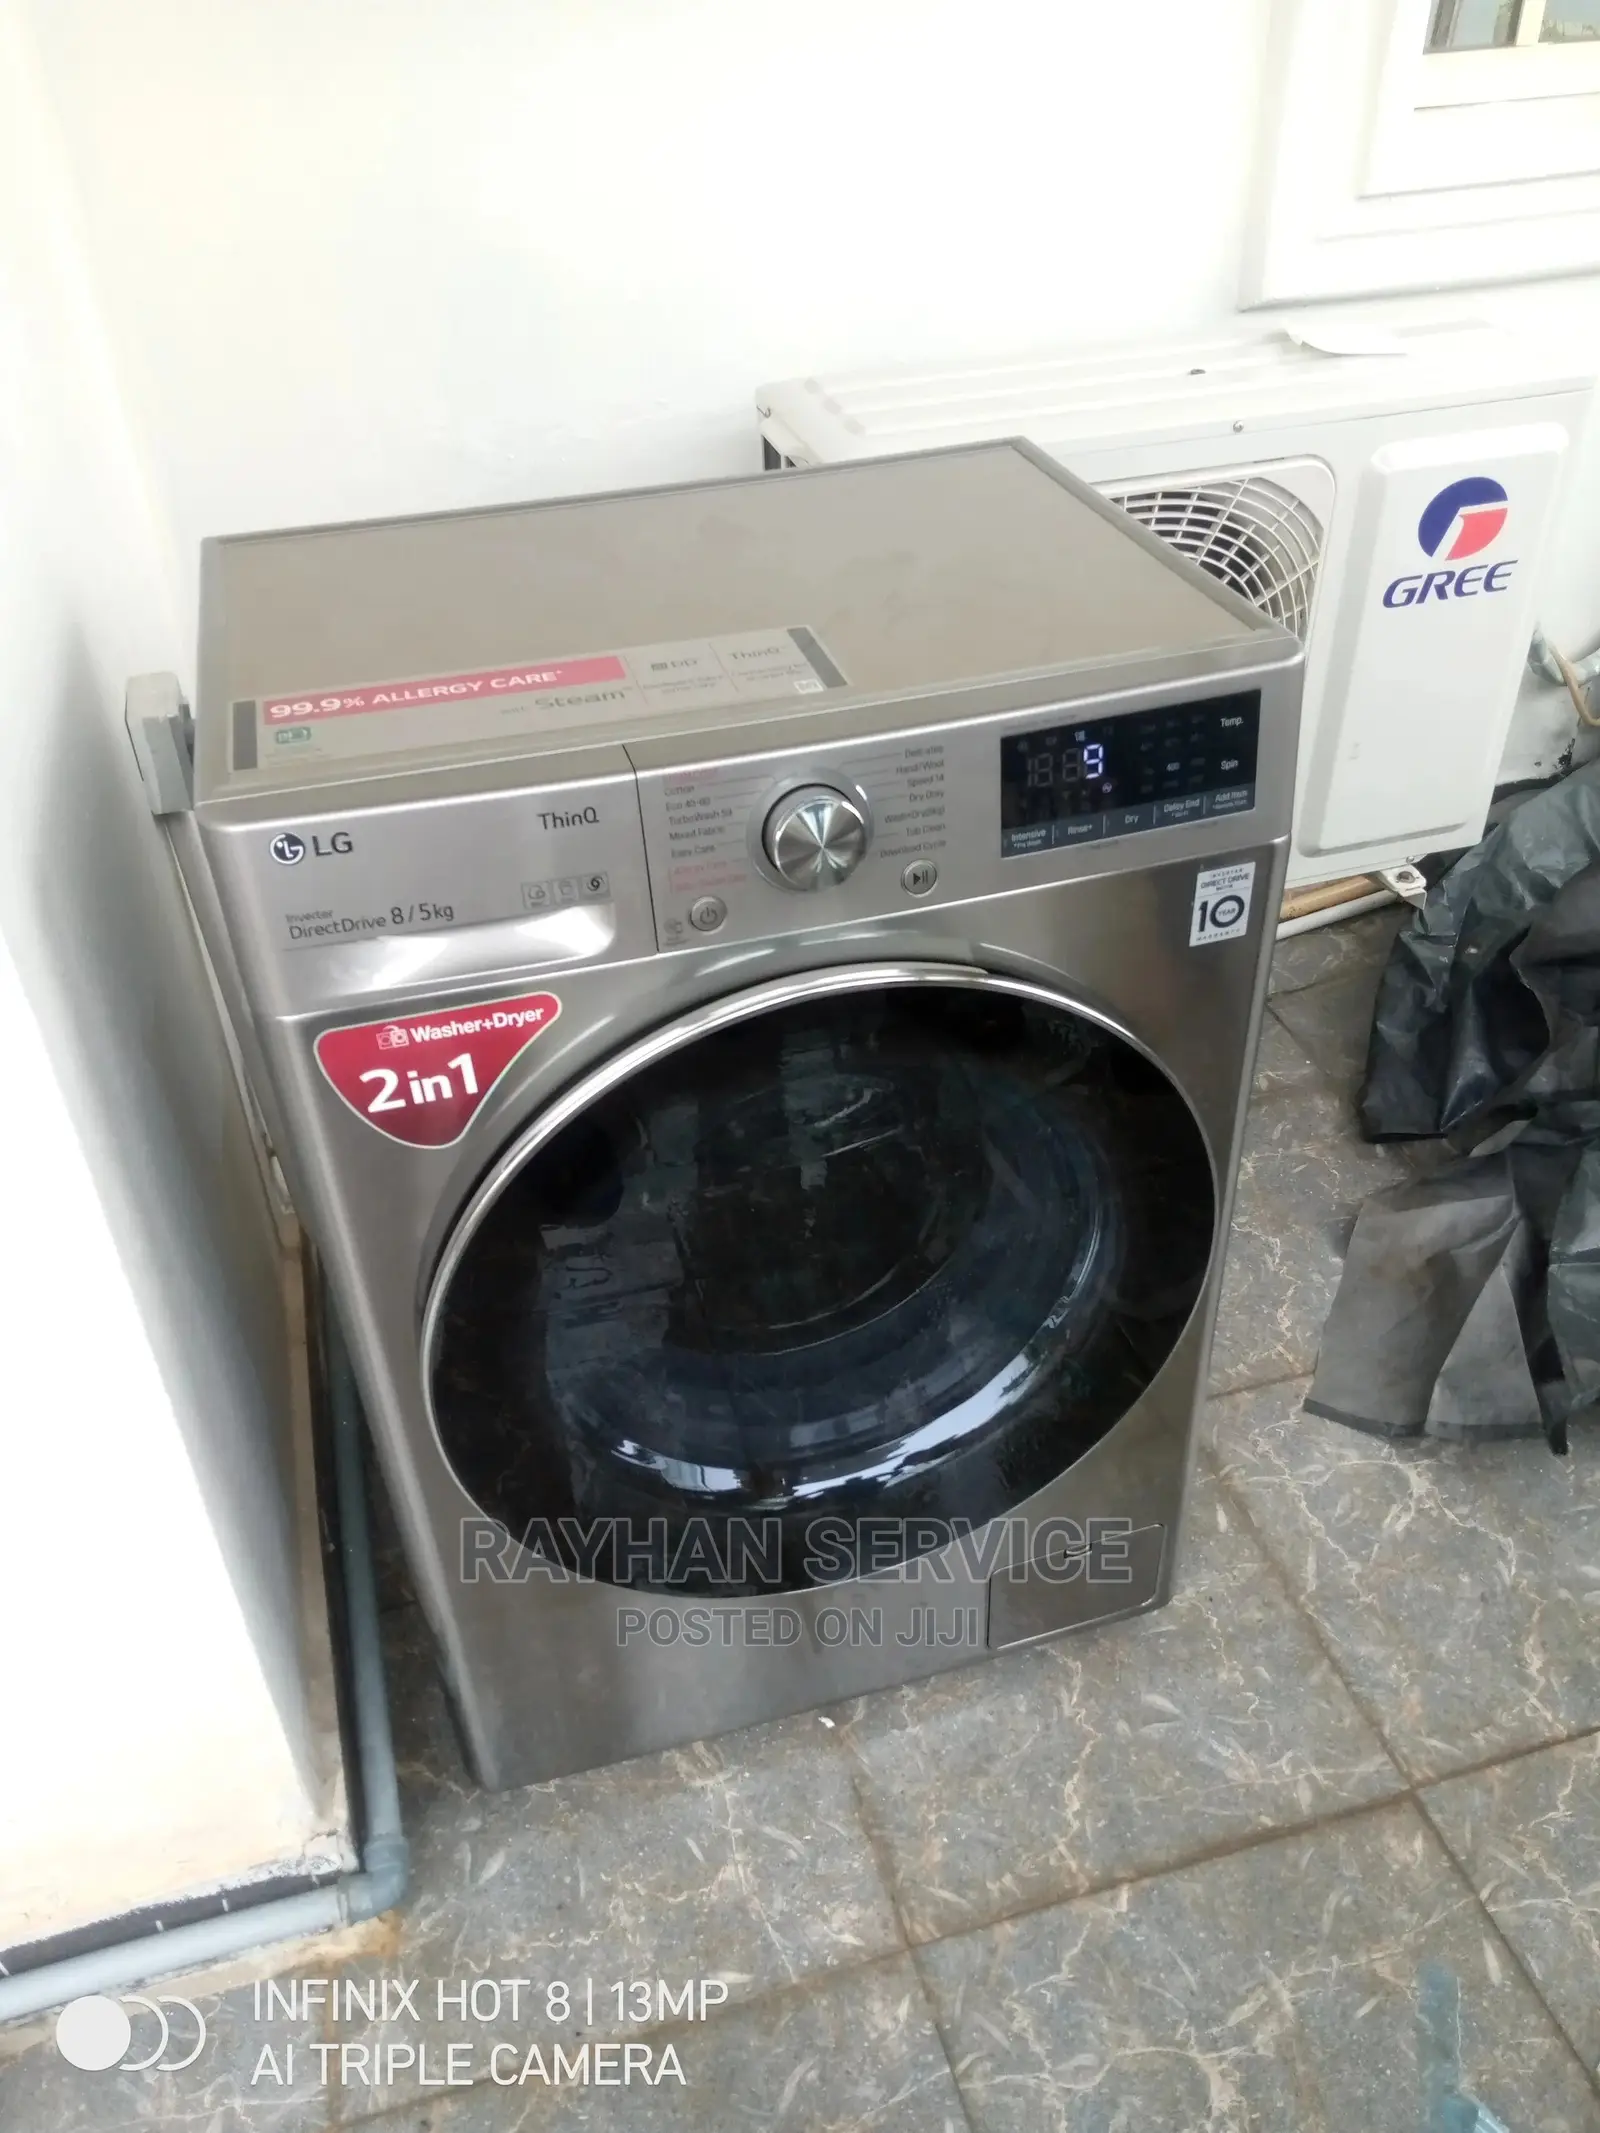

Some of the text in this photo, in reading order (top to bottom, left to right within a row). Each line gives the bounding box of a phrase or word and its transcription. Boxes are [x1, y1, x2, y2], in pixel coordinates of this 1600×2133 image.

[1382, 559, 1518, 608] GREE
[270, 696, 365, 719] 99.9%
[372, 680, 482, 705] ALLERGY
[1220, 716, 1244, 728] Temp.
[1220, 759, 1239, 771] Spin
[1185, 798, 1200, 809] End
[537, 806, 600, 831] ThinQ
[1124, 814, 1139, 824] Dry
[312, 831, 353, 857] LG
[1011, 829, 1047, 843] Intensive
[1200, 873, 1249, 889] DIRECT DRIVE
[285, 908, 334, 924] Inverter
[1198, 895, 1245, 933] 10
[1218, 908, 1237, 917] YEAR
[288, 914, 388, 940] DirectDrive
[410, 1007, 544, 1043] Washer+Dryer
